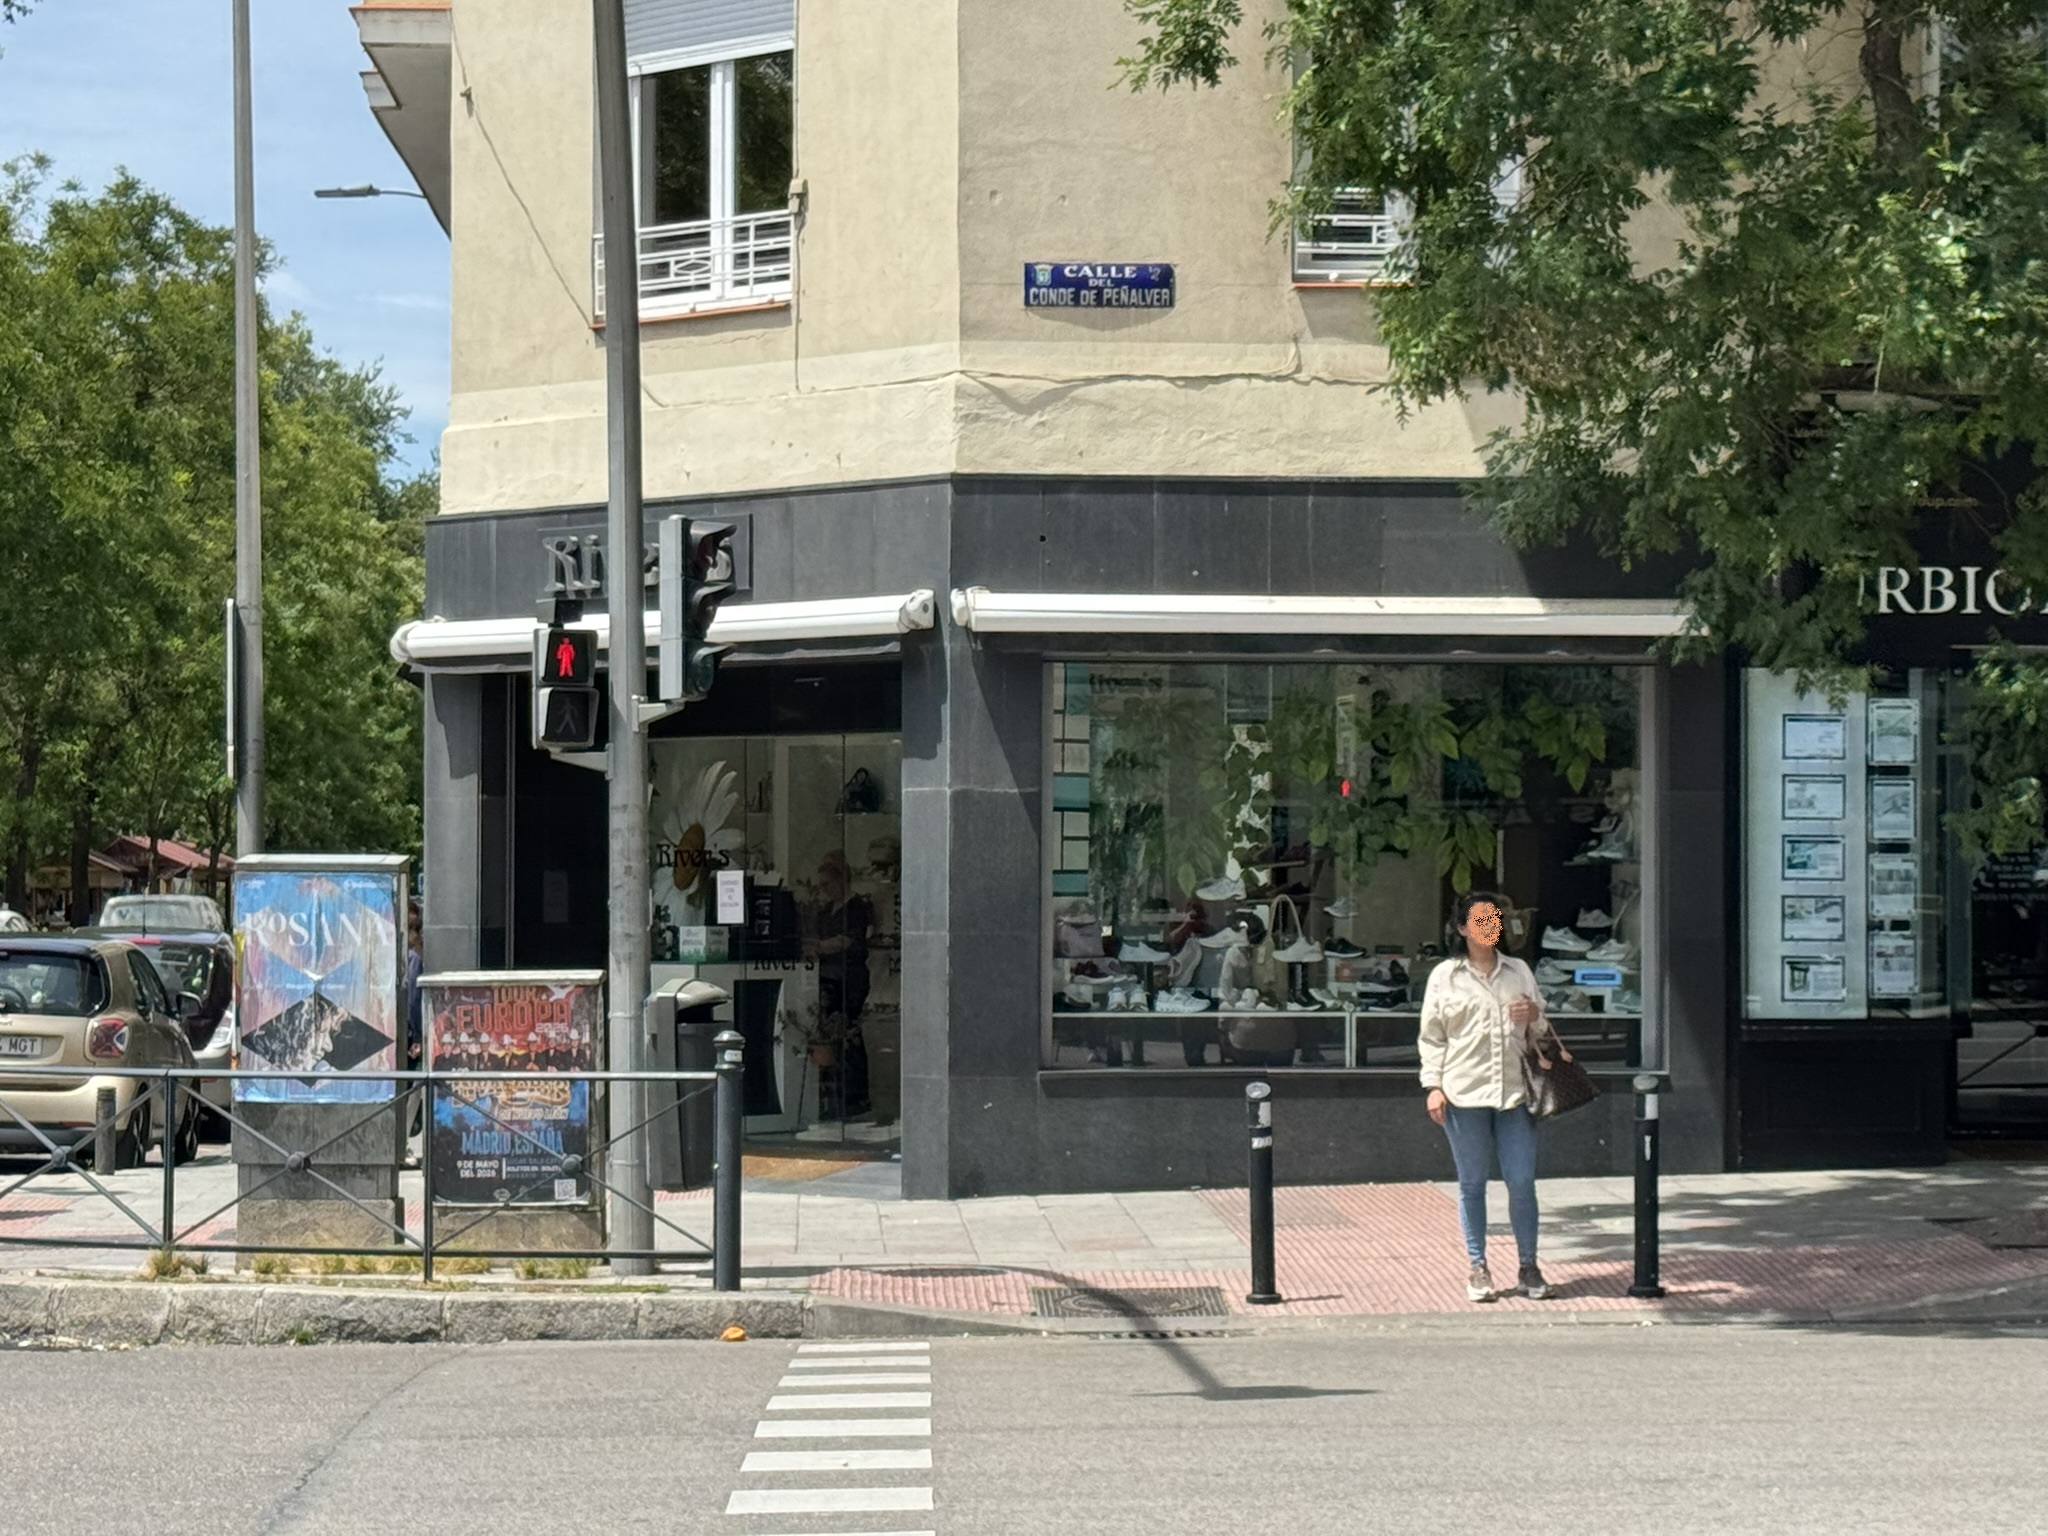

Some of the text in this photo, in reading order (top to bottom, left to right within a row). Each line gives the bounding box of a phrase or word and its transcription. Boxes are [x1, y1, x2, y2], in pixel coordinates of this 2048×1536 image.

[1064, 266, 1138, 278] CALLE
[1088, 278, 1115, 287] DEL
[1029, 286, 1170, 306] CONDE DE PEÑALVER
[1856, 566, 2048, 615] RBIO
[456, 1000, 572, 1034] EUROPA
[8, 1037, 38, 1053] MGT
[463, 1160, 473, 1169] DE
[475, 1160, 500, 1169] MAYO
[460, 1169, 475, 1179] DEL
